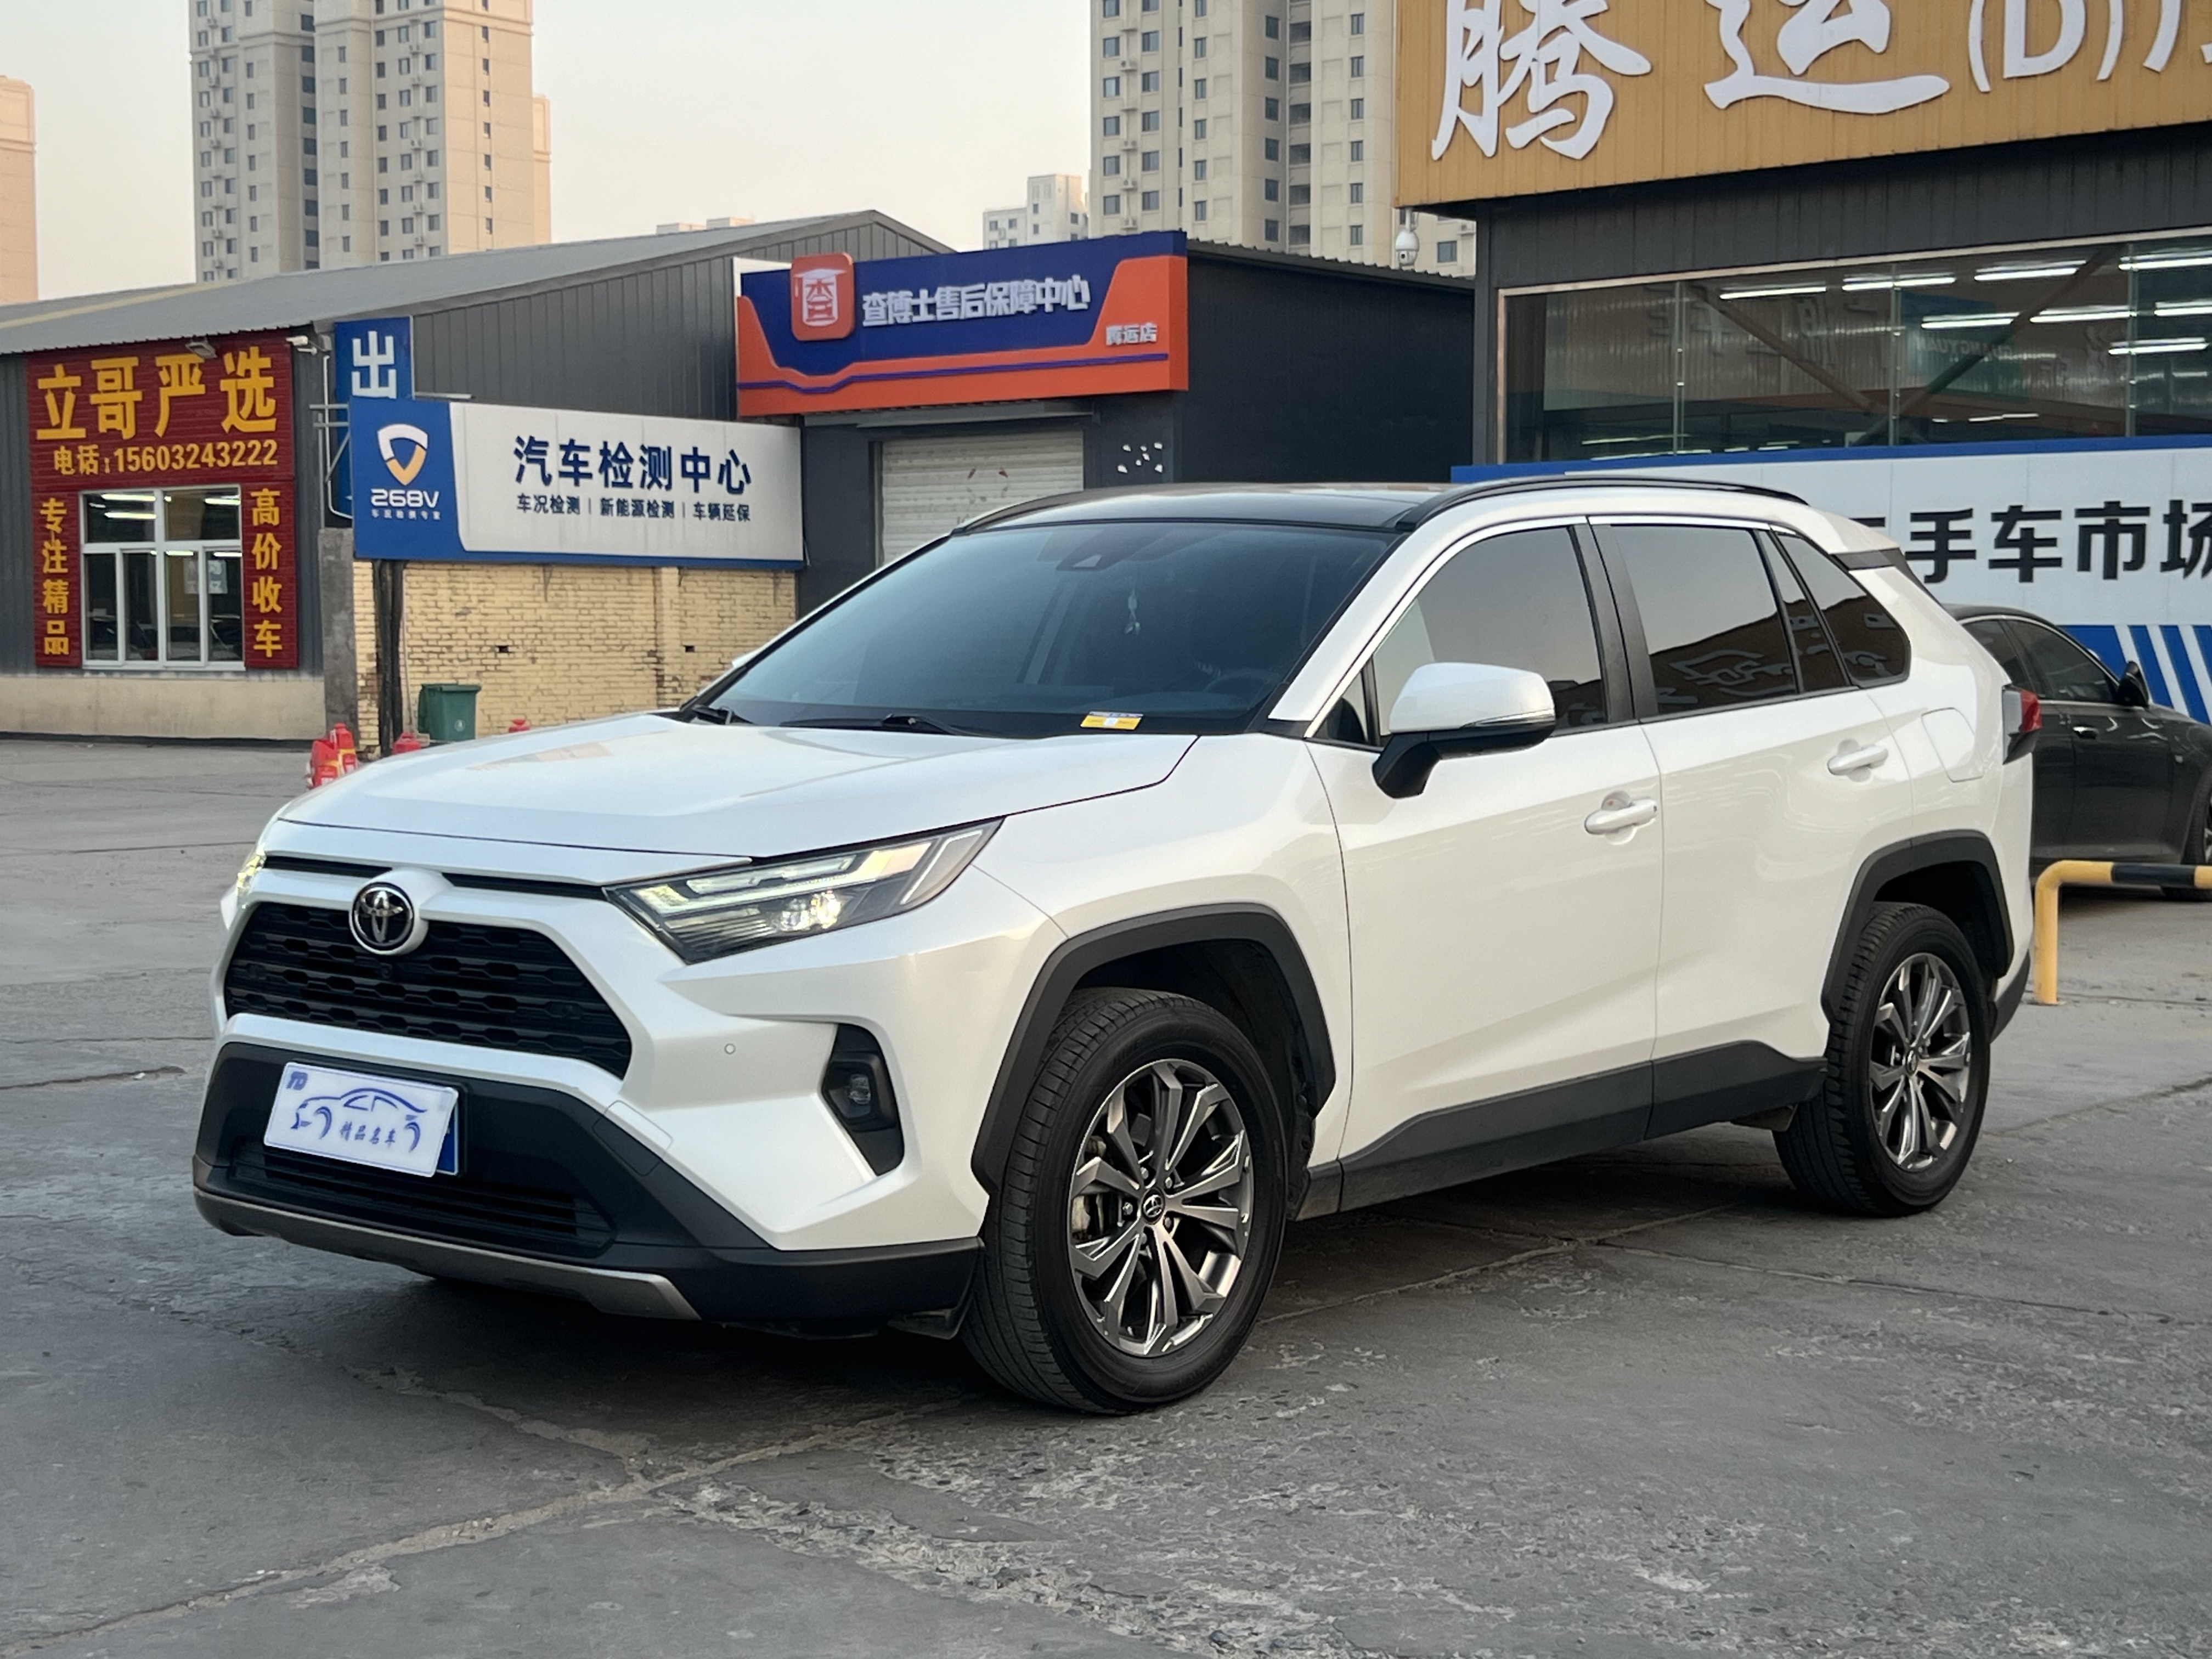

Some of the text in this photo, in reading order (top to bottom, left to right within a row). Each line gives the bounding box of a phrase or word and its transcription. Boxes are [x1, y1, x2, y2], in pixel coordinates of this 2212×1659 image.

[1431, 0, 2212, 160] 腾运(D)
[862, 274, 1091, 326] 查博士售后保障中心
[36, 346, 277, 440] 立哥严选
[352, 330, 397, 399] 出
[371, 488, 439, 508] 268V
[514, 435, 752, 495] 汽车检测中心
[517, 493, 751, 522] 车况检测 新能源检测 车辆延保
[1849, 499, 2212, 583] 手车市场
[40, 497, 70, 656] 专注精品
[251, 487, 283, 658] 高价收车
